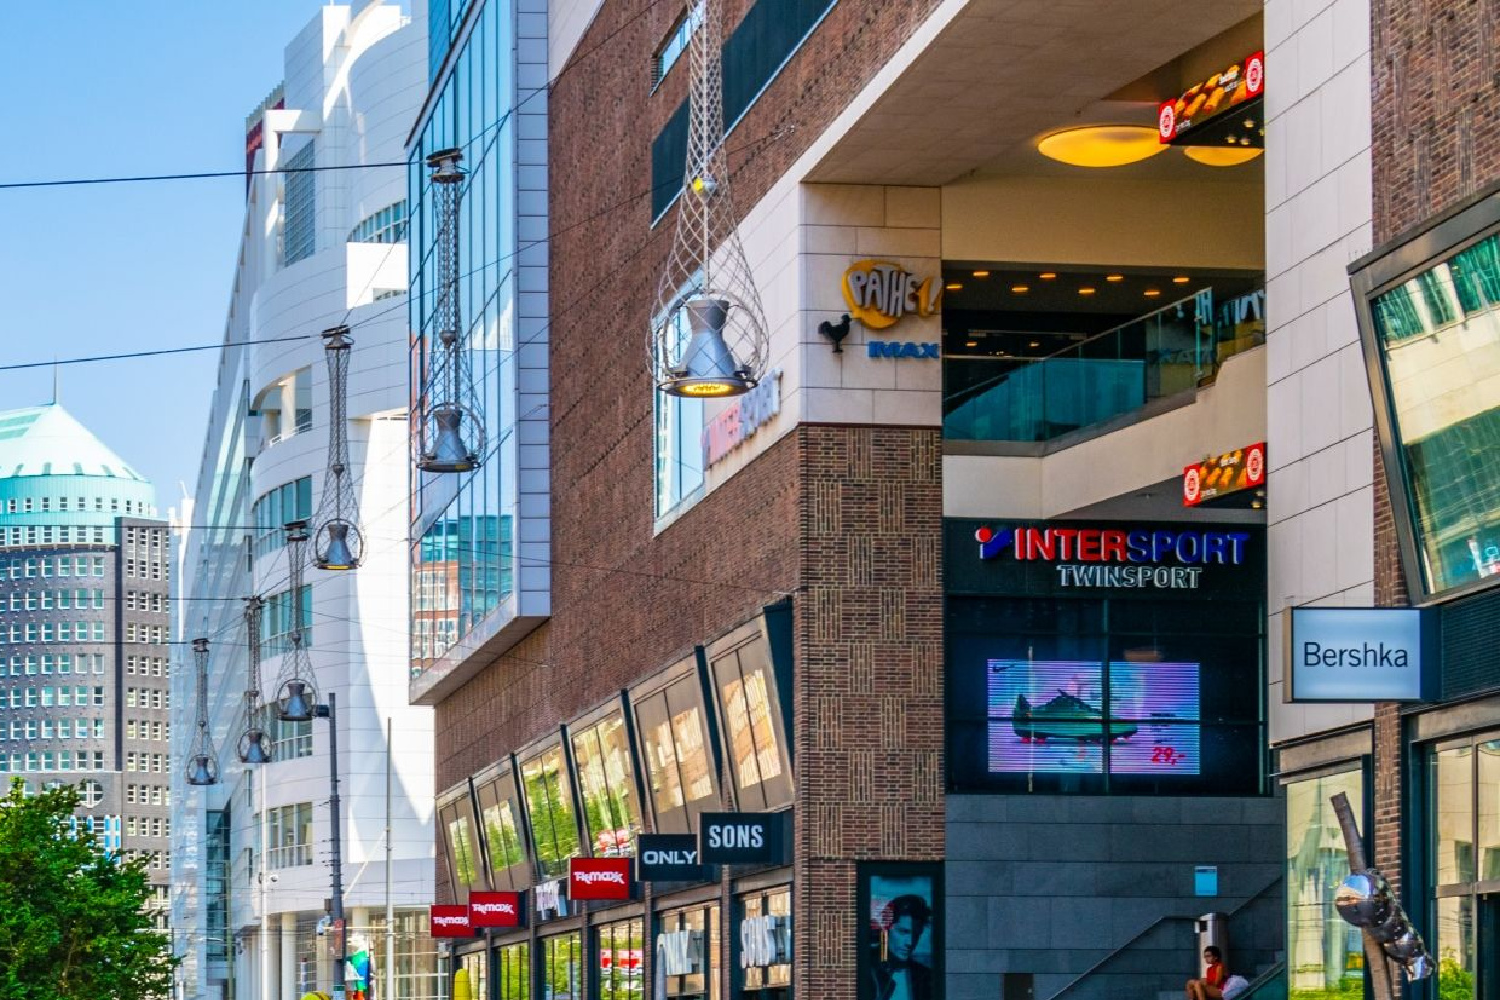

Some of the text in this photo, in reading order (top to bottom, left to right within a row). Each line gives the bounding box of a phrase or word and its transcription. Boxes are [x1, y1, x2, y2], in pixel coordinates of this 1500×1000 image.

[868, 341, 940, 358] IMAX
[1015, 528, 1249, 563] INTERSPORT
[1057, 564, 1201, 588] TWINSPORT
[1303, 641, 1409, 668] Bershka
[708, 824, 763, 848] SONS
[643, 850, 697, 865] ONLY
